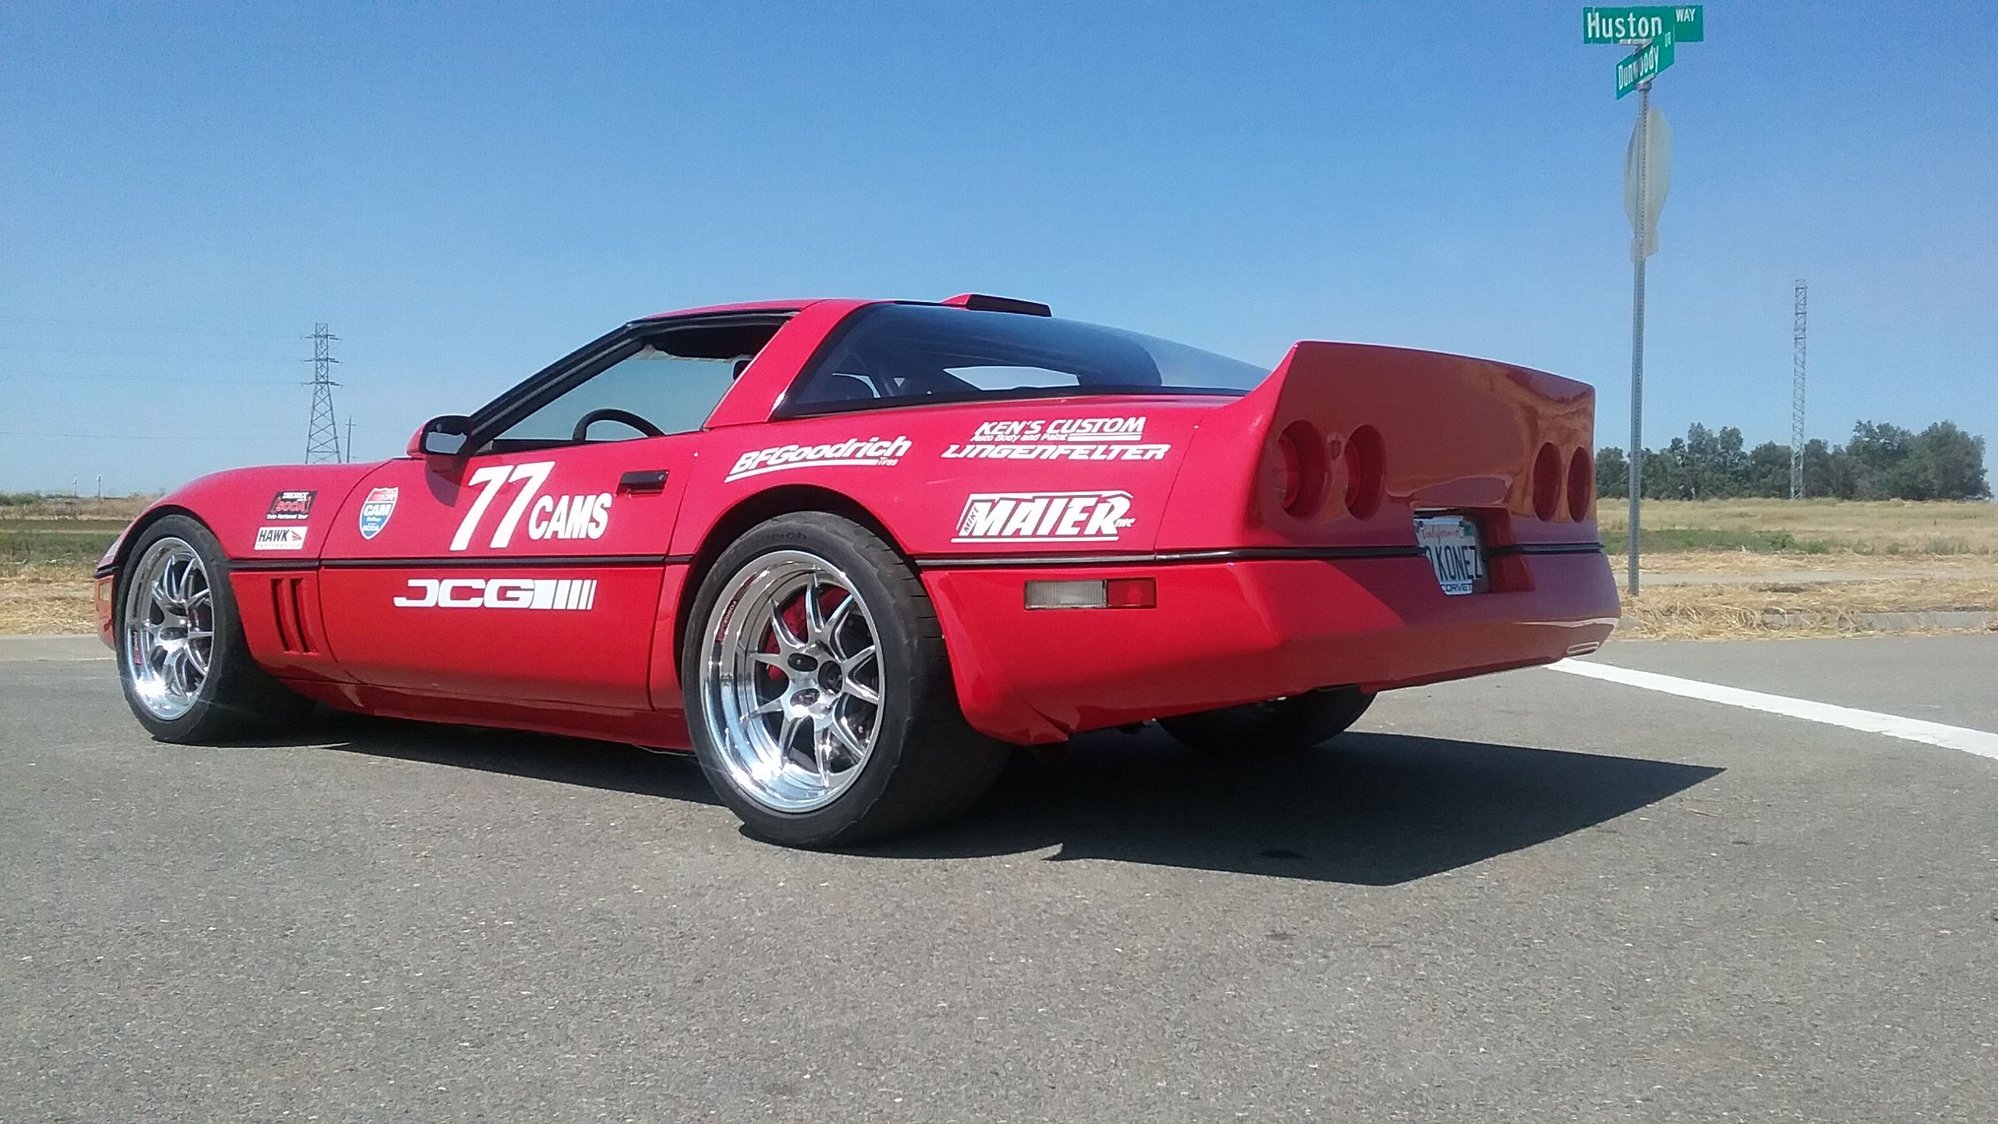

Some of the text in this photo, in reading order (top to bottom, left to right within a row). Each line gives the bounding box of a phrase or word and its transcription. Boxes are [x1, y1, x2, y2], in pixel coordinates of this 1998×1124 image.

[1587, 8, 1696, 38] Huston WAY
[974, 416, 1147, 434] KEN'S CUSTOM
[729, 436, 912, 475] BFGoodrich
[940, 443, 1172, 460] LINGENFELTER
[363, 504, 391, 516] CAM
[449, 461, 613, 551] 77 CAMS
[958, 494, 1131, 536] MAIER
[258, 529, 290, 542] HAWK
